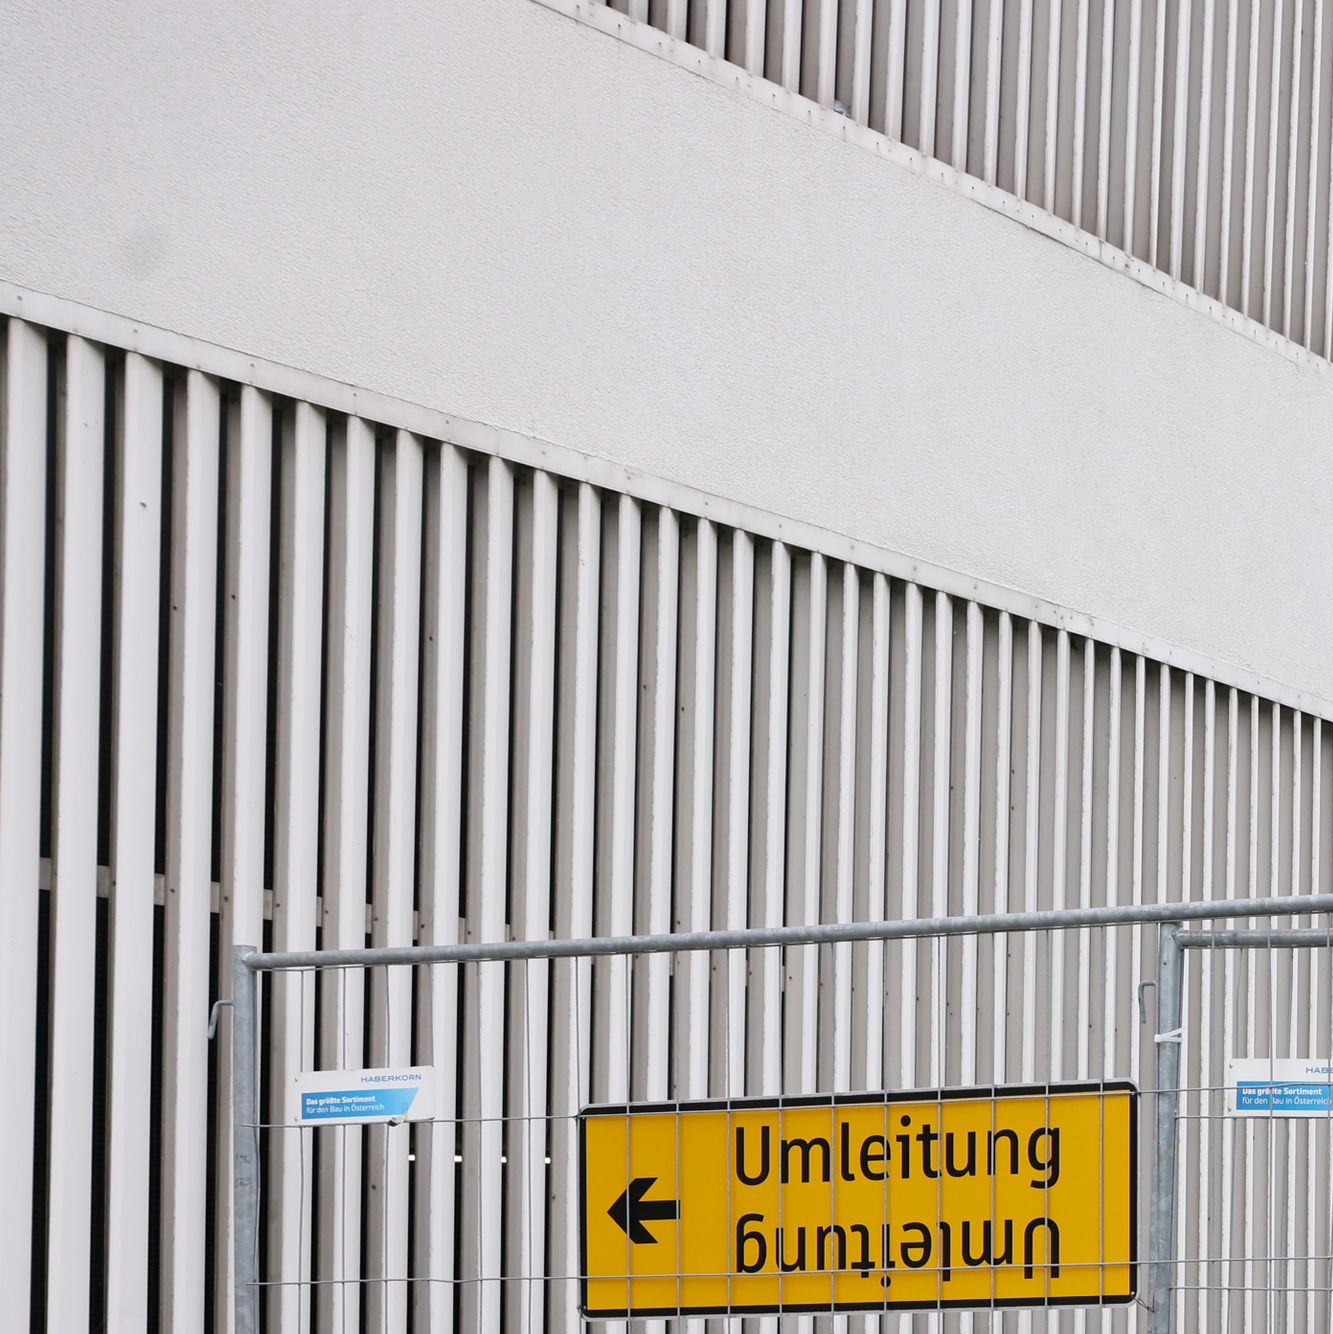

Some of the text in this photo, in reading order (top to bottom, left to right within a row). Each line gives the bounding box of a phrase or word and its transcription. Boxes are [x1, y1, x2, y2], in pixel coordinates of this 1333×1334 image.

[360, 1073, 422, 1083] HABERKORN
[1242, 1087, 1256, 1095] Das
[1283, 1087, 1322, 1095] Sortiment
[319, 1096, 341, 1106] größte
[341, 1096, 376, 1104] Sortiment
[351, 1103, 385, 1112] Österreich
[735, 1115, 1061, 1189] Umleitung
[735, 1213, 1060, 1288] Umleitung
